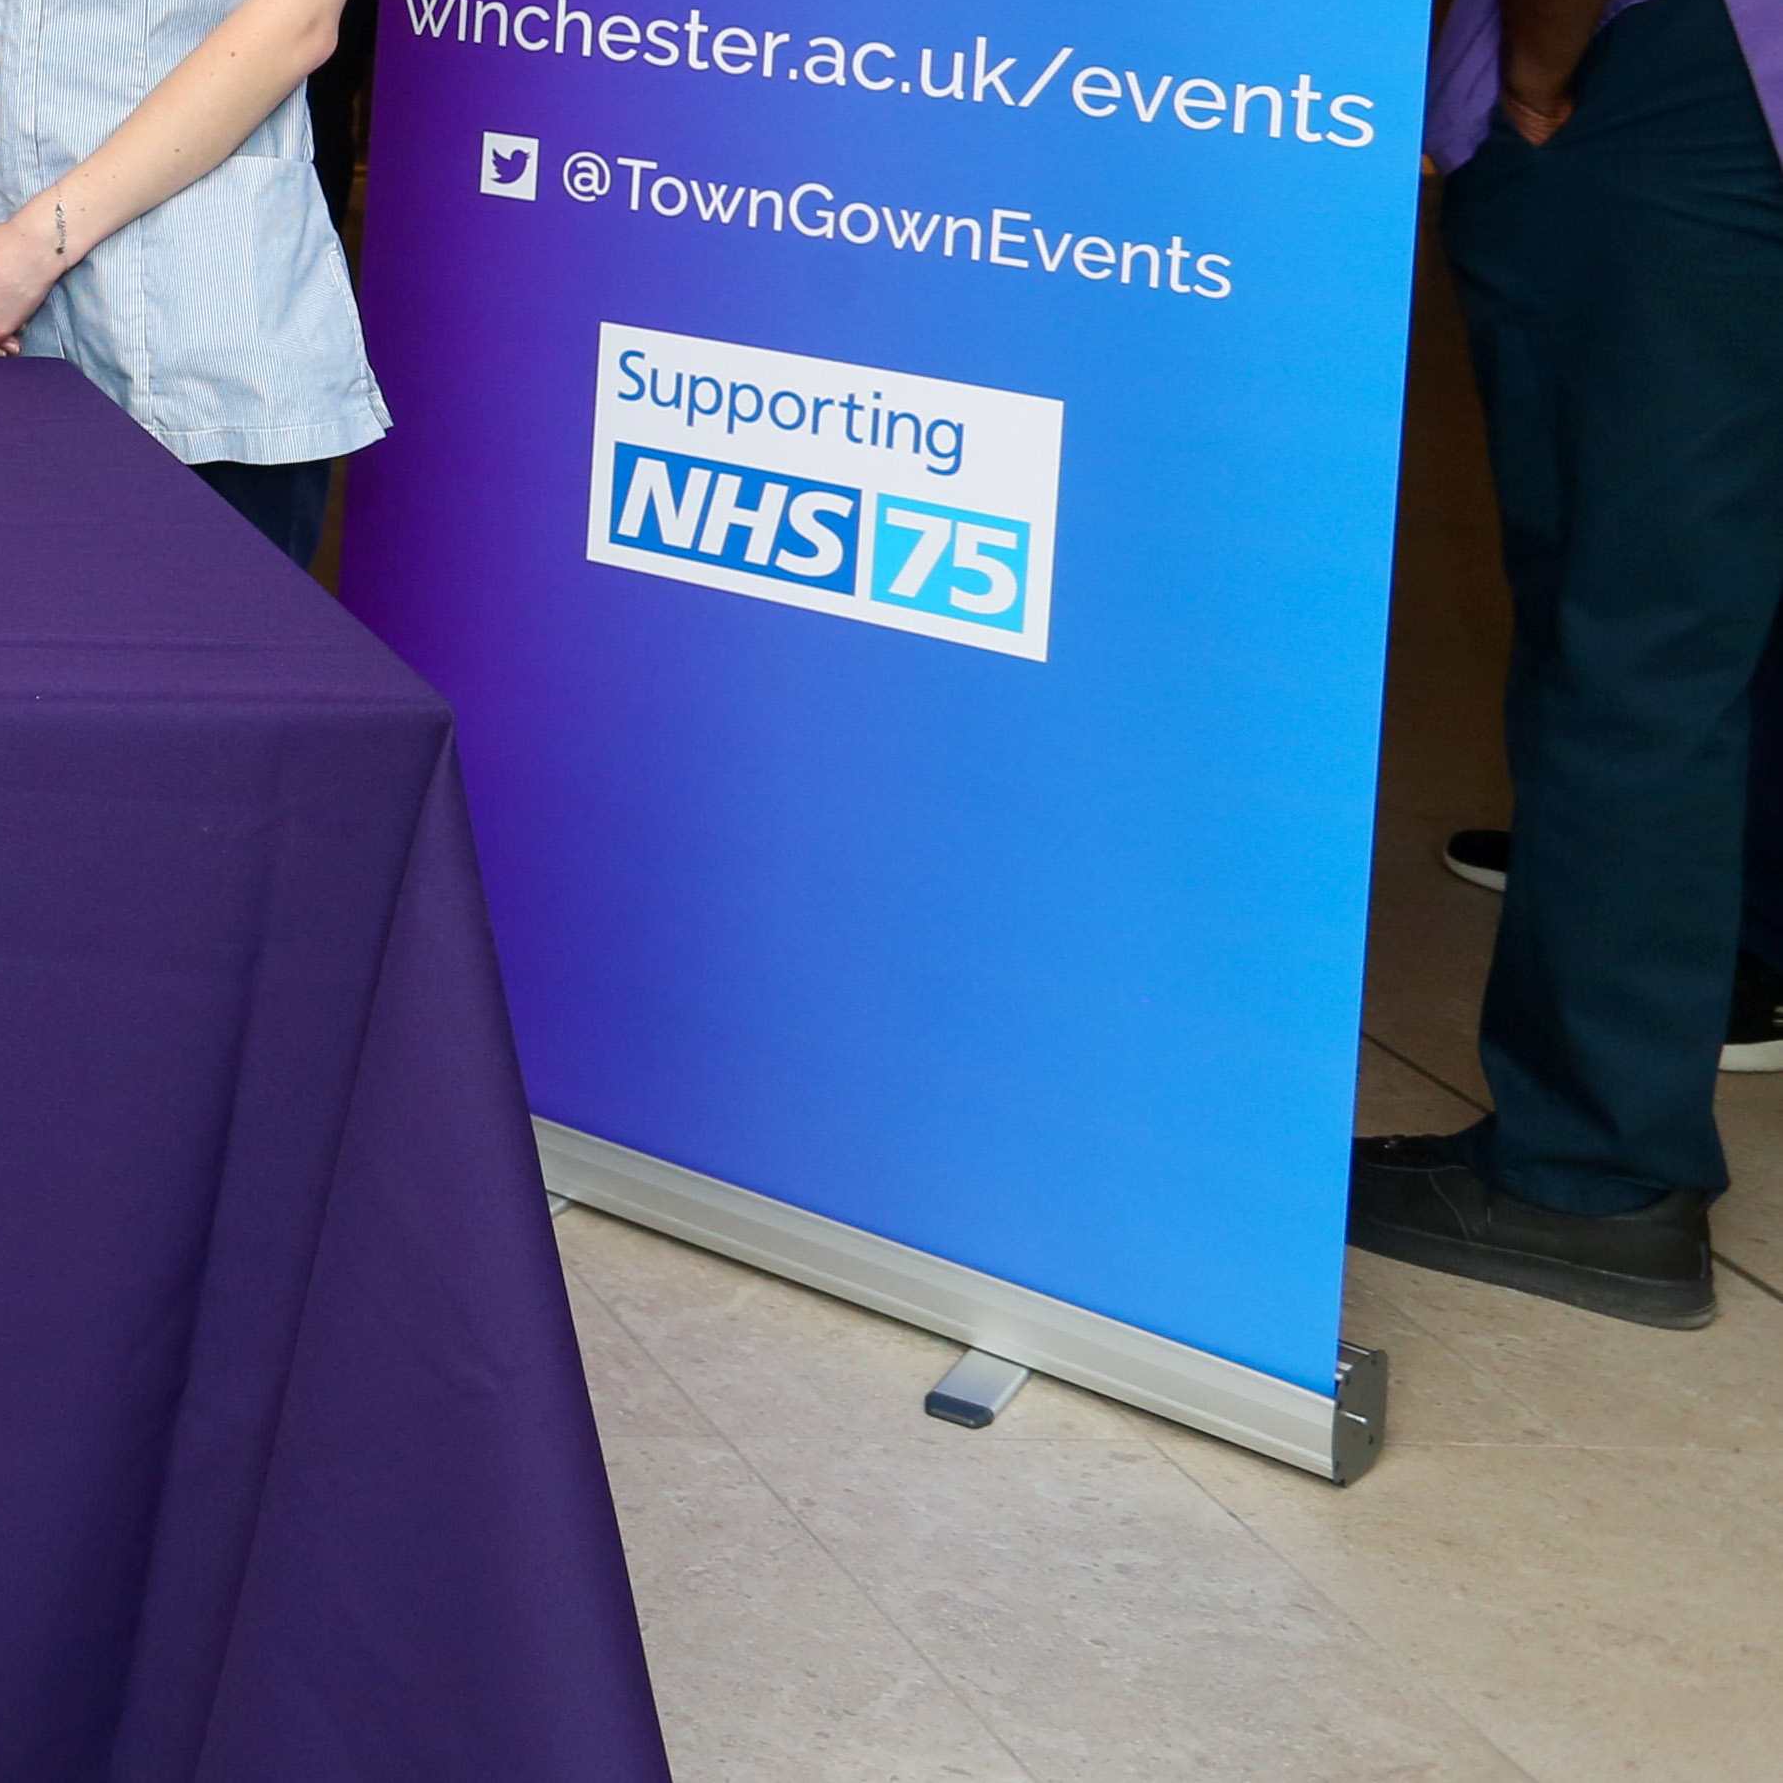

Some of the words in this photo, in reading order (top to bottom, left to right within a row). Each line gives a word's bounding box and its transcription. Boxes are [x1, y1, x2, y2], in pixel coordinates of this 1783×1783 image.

[563, 151, 1233, 299] @TownGownEvents
[616, 349, 965, 477] Supporting
[616, 455, 855, 579] NHS
[884, 506, 1019, 616] 75
